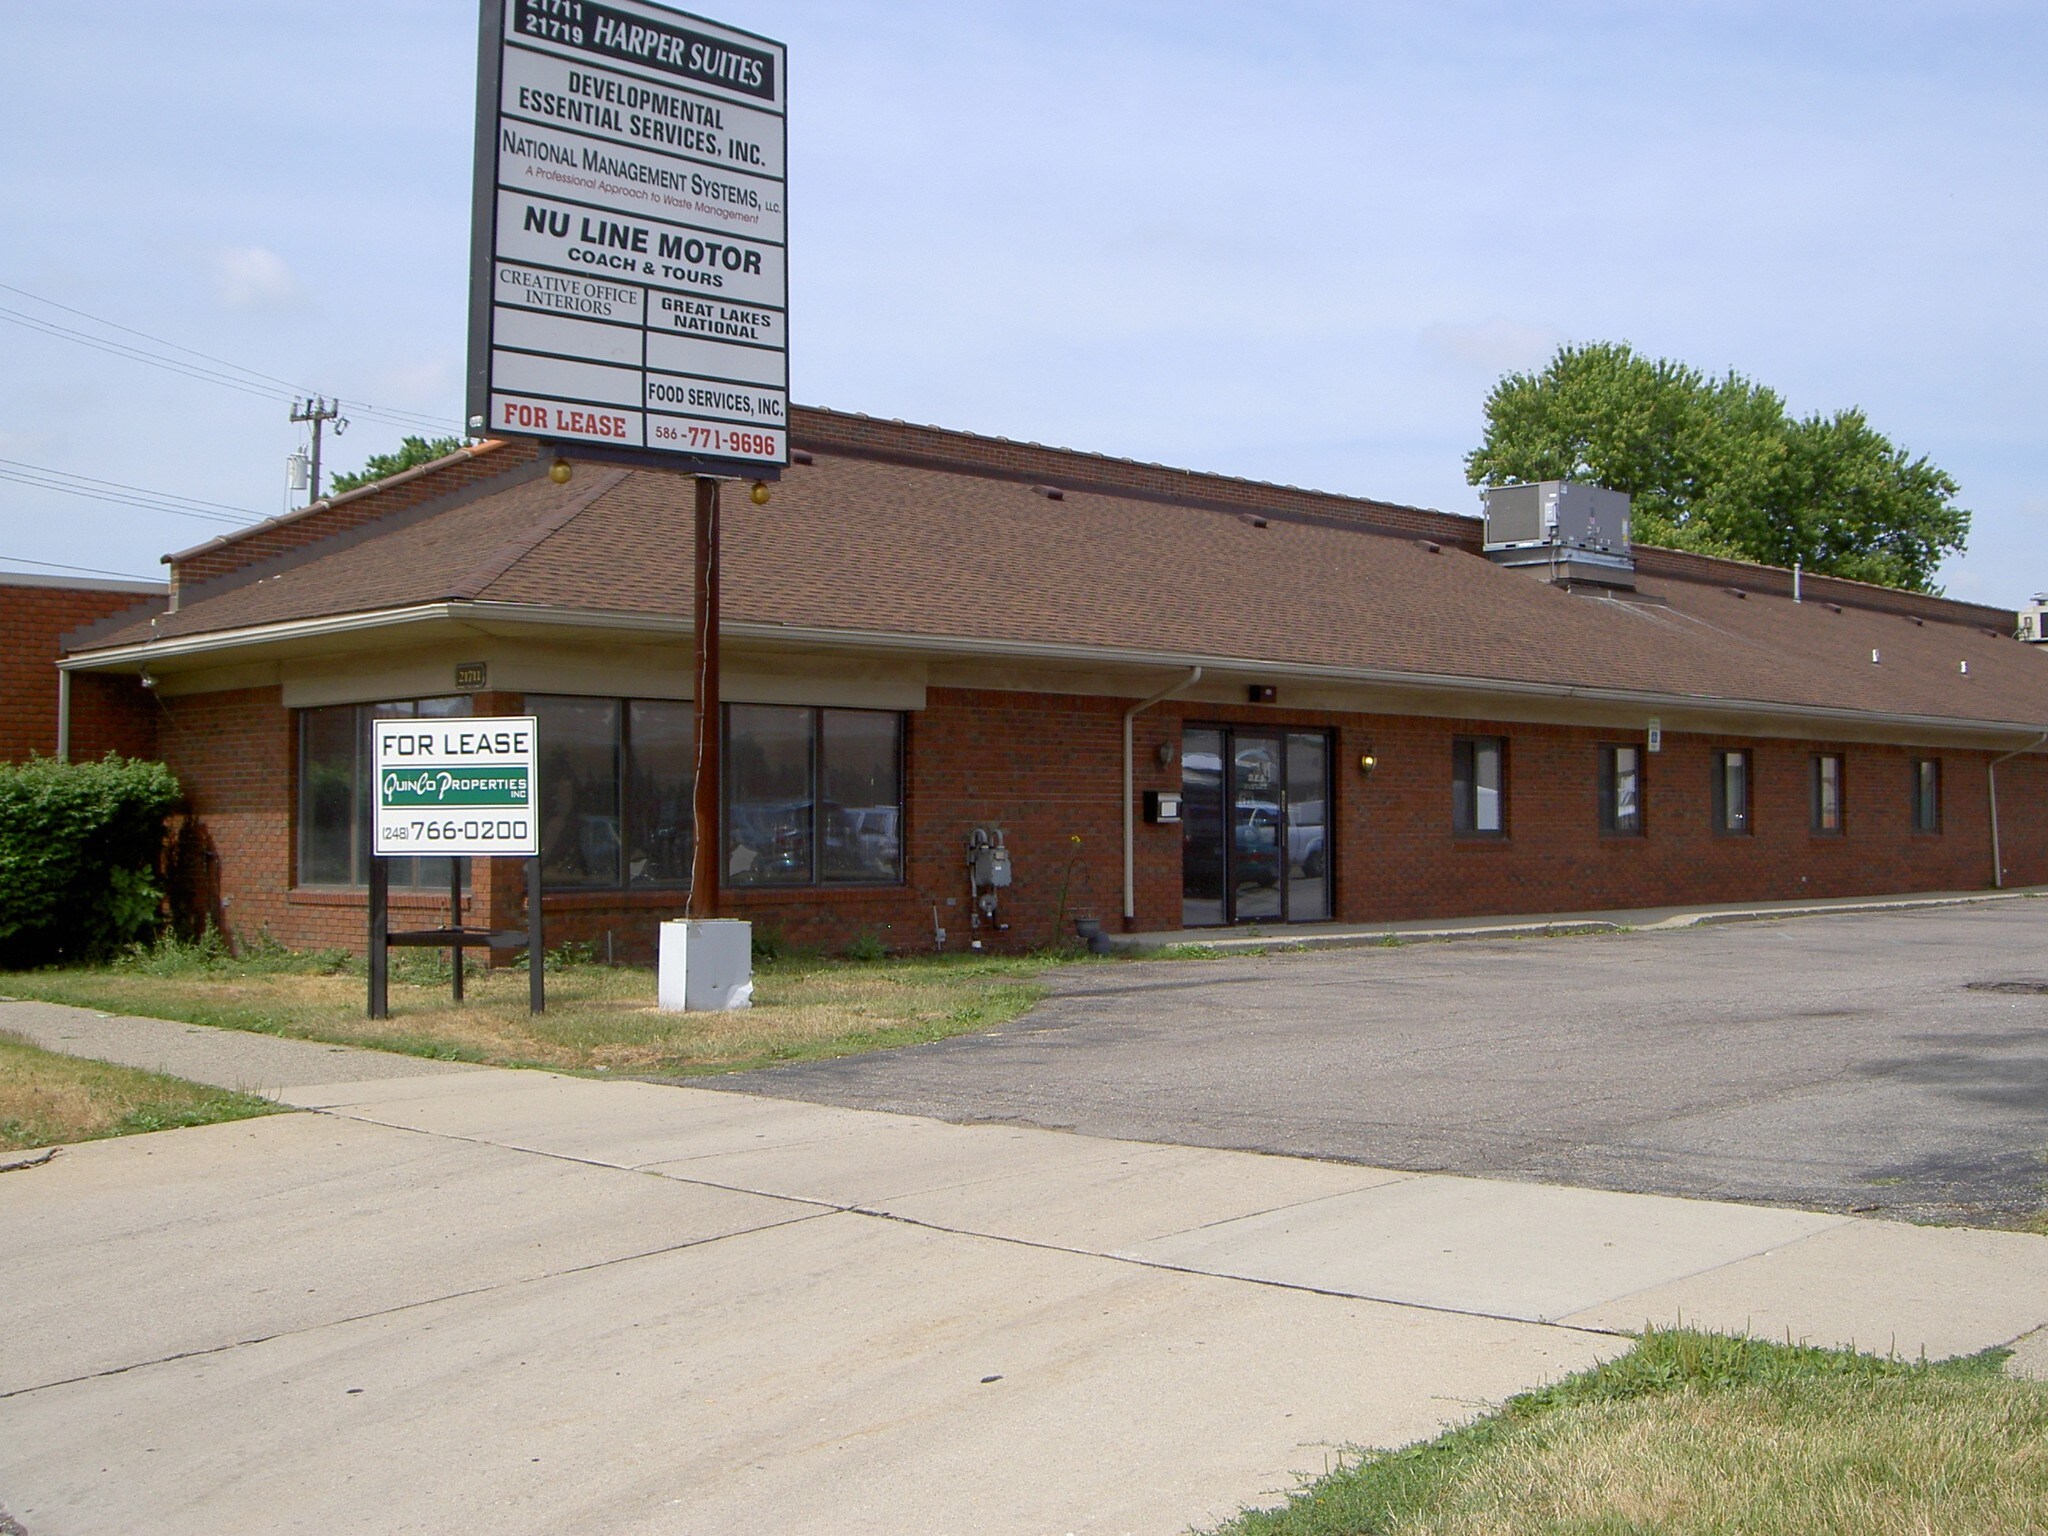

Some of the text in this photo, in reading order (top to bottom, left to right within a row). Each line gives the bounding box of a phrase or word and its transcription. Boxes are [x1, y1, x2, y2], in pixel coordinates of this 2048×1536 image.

[526, 13, 583, 44] 21719
[594, 16, 763, 87] HARPER SUITES
[569, 71, 724, 130] DEVELOPMENTAL
[519, 87, 766, 166] ESSENTIAL SERVICES, INC.
[503, 129, 781, 213] NATIONAL MANAGEMENT SYSTEMS, LLC.
[525, 166, 759, 224] A Professional Approach to Waste Management
[523, 206, 762, 275] NU LINE MOTOR
[568, 248, 723, 287] COACH & TOURS
[500, 269, 637, 305] CREATIVE OFFICE
[526, 289, 612, 316] INTERIORS
[661, 297, 771, 327] GREAT LAKES
[674, 315, 759, 340] NATIONAL
[648, 383, 784, 417] FOOD SERVICES, INC.
[504, 403, 626, 438] FOR LEASE
[383, 733, 528, 755] FOR LEASE
[436, 772, 527, 800] PROPERTIES
[511, 790, 526, 798] INC
